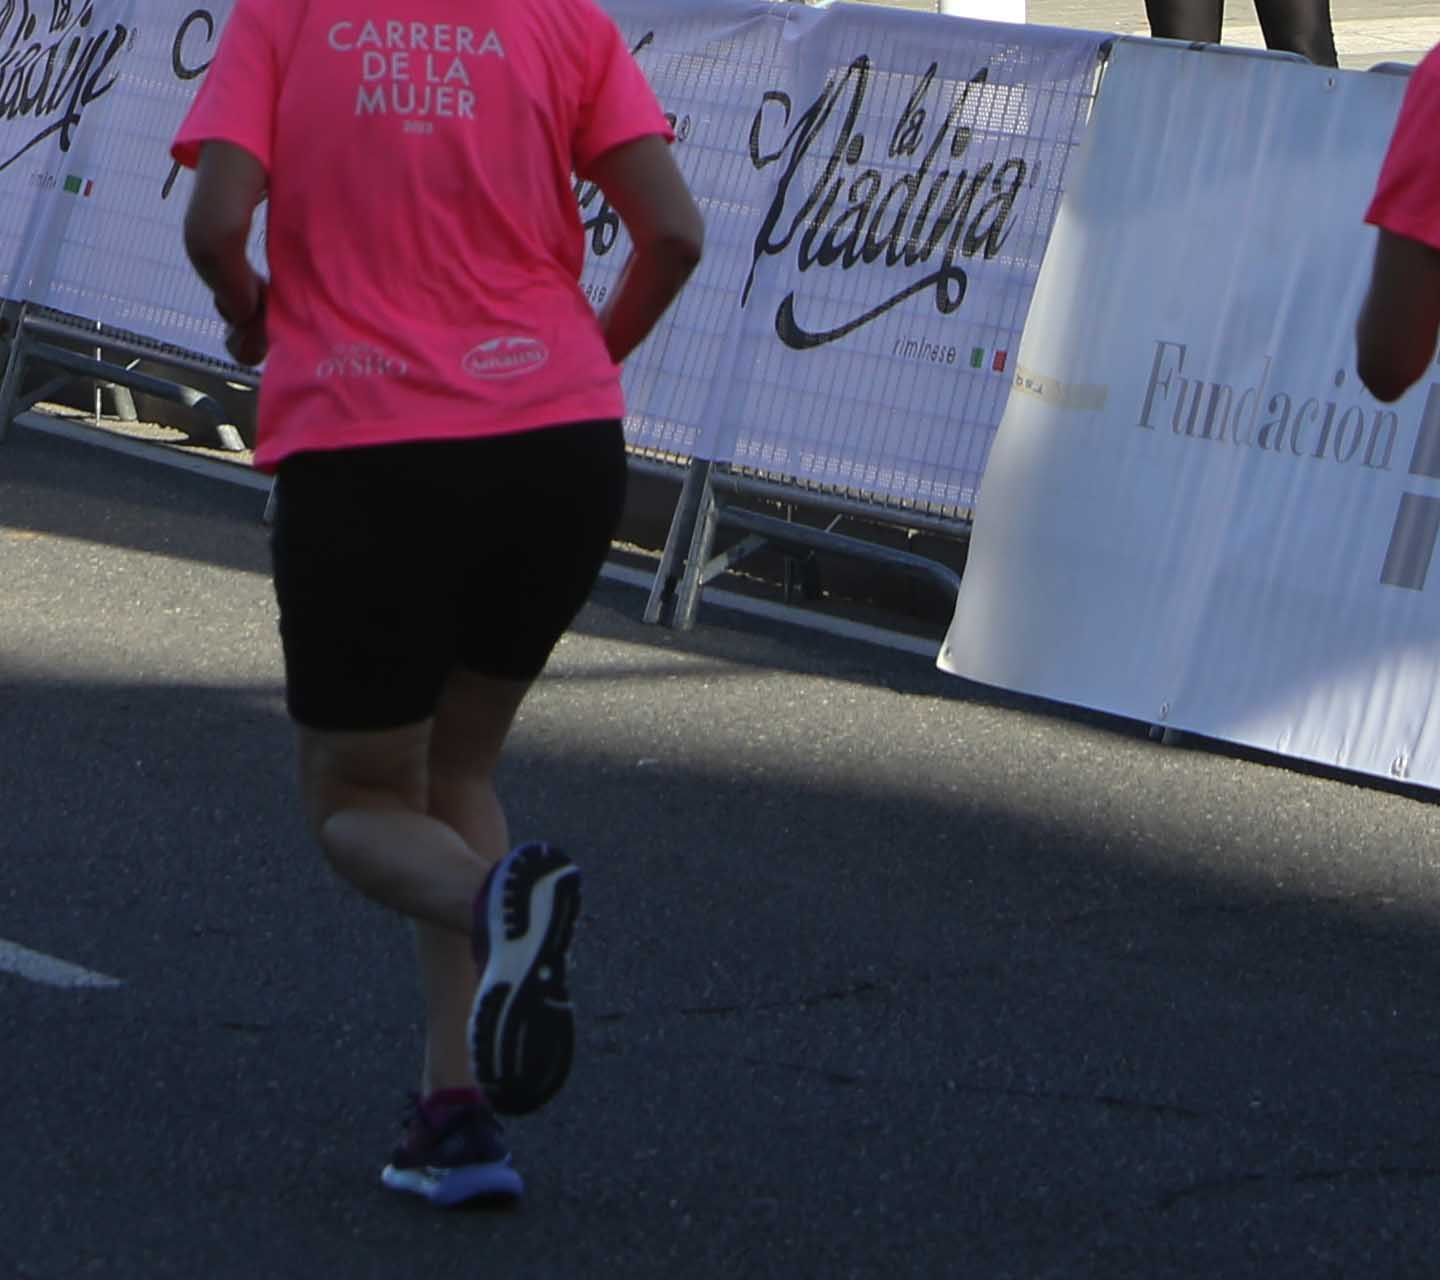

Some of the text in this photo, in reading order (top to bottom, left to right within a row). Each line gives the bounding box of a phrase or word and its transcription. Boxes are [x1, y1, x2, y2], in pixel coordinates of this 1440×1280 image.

[327, 21, 506, 59] CARRERA
[361, 51, 471, 88] DE LA
[354, 83, 477, 120] MUJER
[892, 336, 958, 366] riminese
[1135, 339, 1401, 472] Fundación
